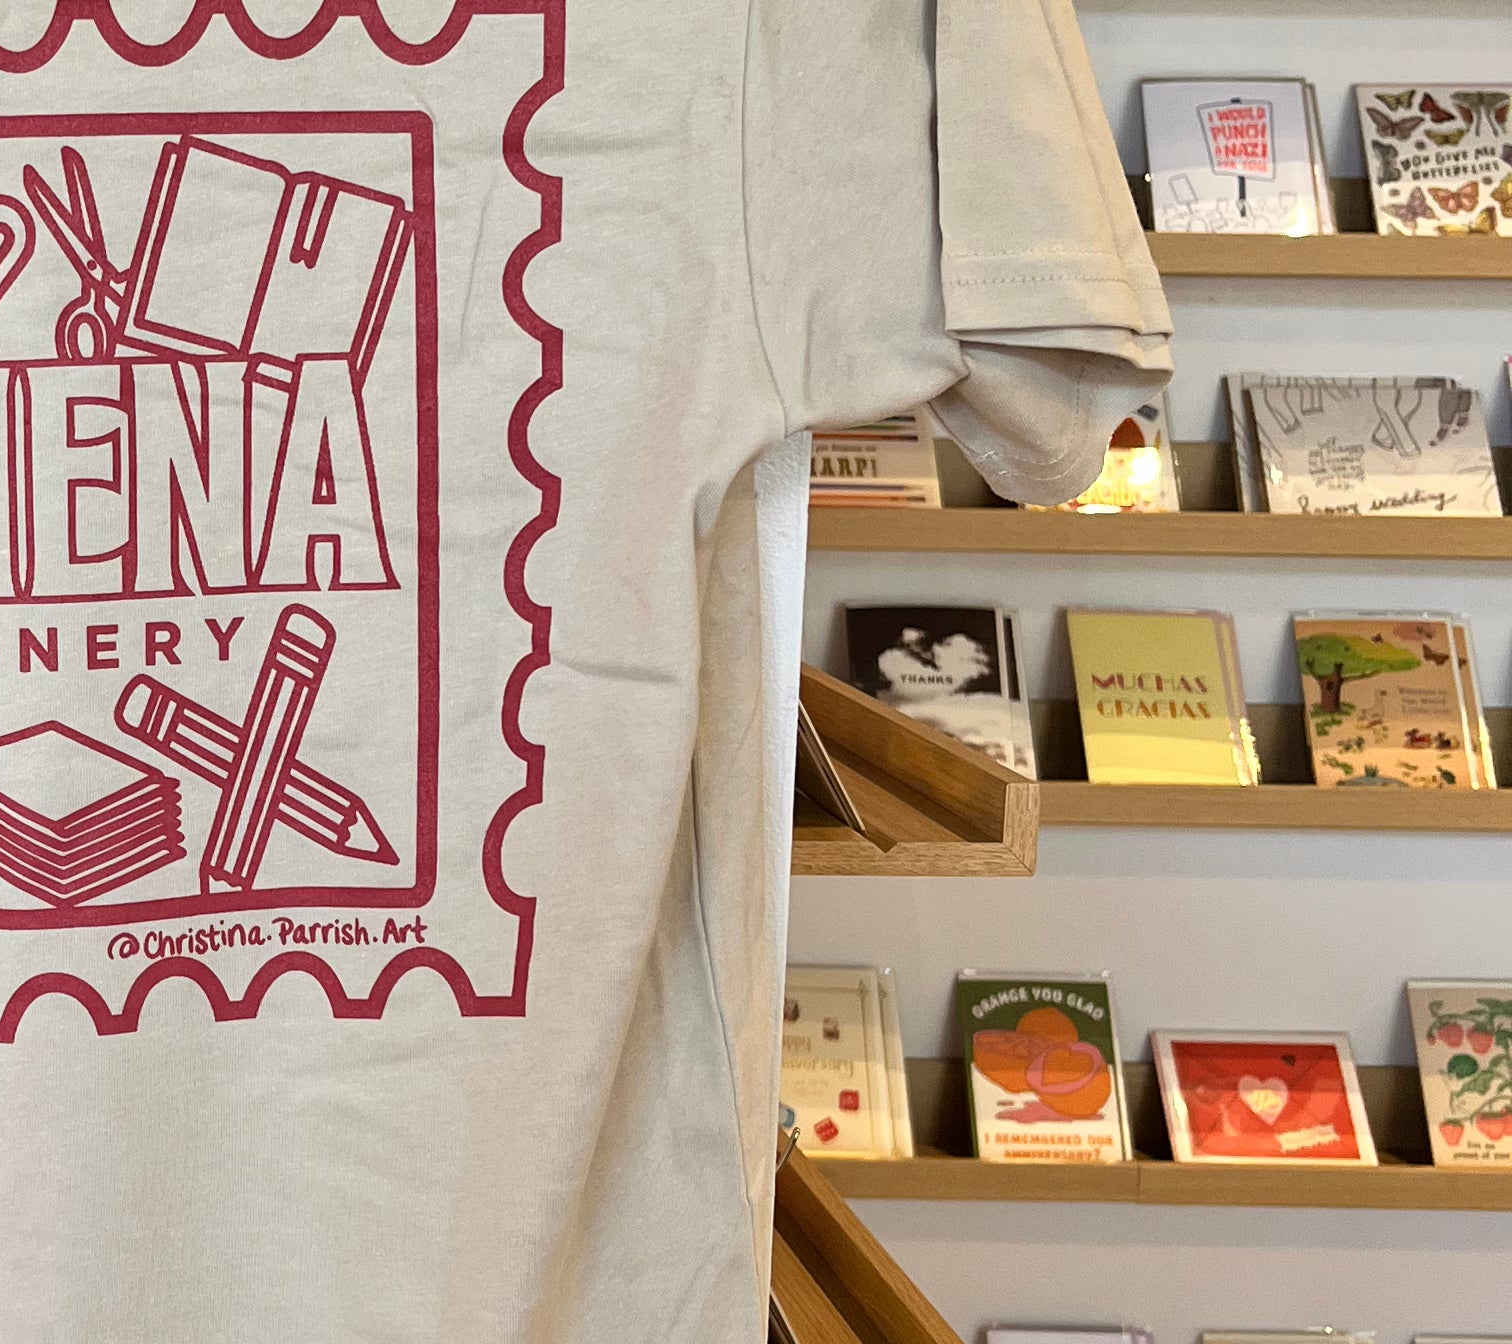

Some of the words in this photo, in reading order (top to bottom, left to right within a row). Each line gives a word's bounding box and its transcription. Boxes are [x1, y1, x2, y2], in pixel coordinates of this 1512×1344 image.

[1209, 122, 1267, 142] PUNCH
[1224, 142, 1267, 158] NAZI
[1400, 155, 1430, 171] YOU
[1434, 150, 1469, 165] GIVE
[1411, 159, 1499, 181] BUTTERFLIES
[899, 673, 954, 685] THANKS
[1090, 671, 1208, 693] MUCHAS
[1096, 697, 1211, 720] GRACIAS
[971, 986, 1029, 1020] ORANGE
[1031, 987, 1064, 1004] YOU
[1066, 992, 1105, 1022] GLAD
